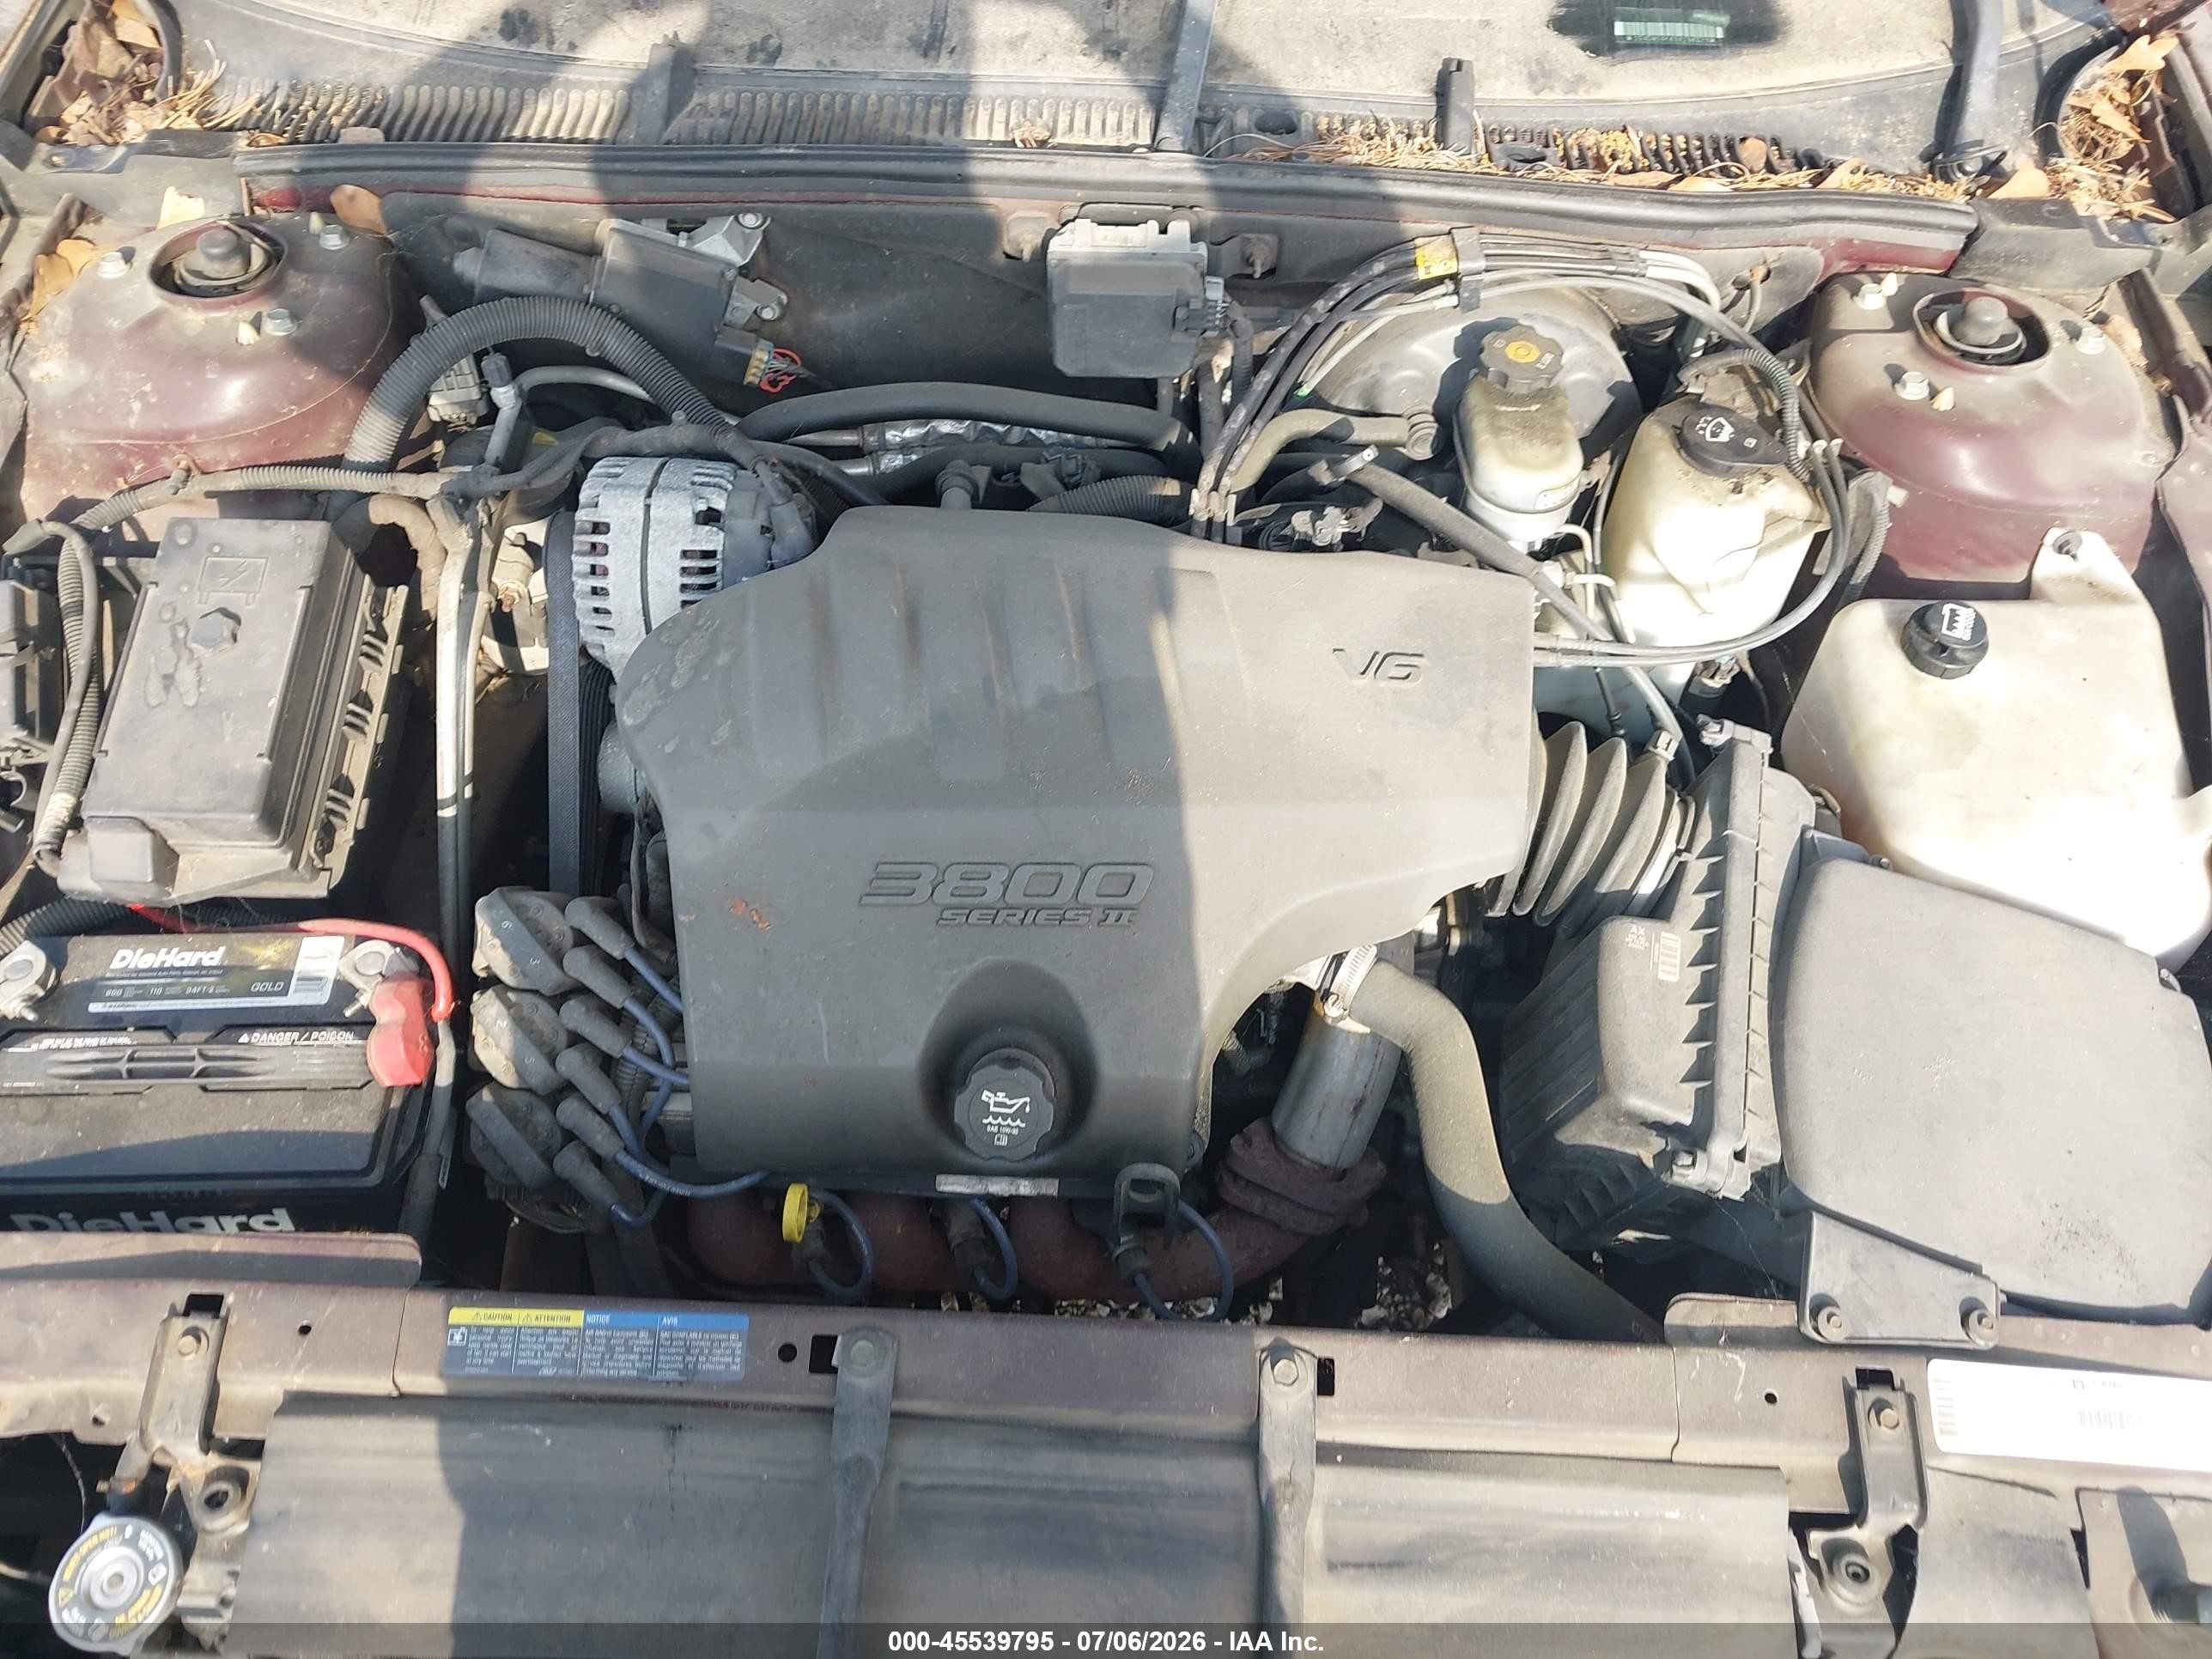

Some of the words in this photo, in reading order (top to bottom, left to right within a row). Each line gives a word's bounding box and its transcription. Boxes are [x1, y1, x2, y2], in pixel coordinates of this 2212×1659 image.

[1333, 647, 1425, 684] V6
[859, 860, 1156, 907] 3800
[936, 907, 1092, 927] SERIES
[1097, 908, 1139, 927] II
[110, 946, 228, 969] DieHard
[251, 981, 285, 993] GOLD
[251, 1031, 300, 1043] DANGER
[310, 1030, 355, 1042] POISON
[9, 1207, 296, 1234] DieHard
[483, 1310, 513, 1321] CAUTION
[534, 1312, 571, 1322] ATTENTION
[586, 1314, 611, 1324] NOTICE
[661, 1316, 678, 1326] AVIS
